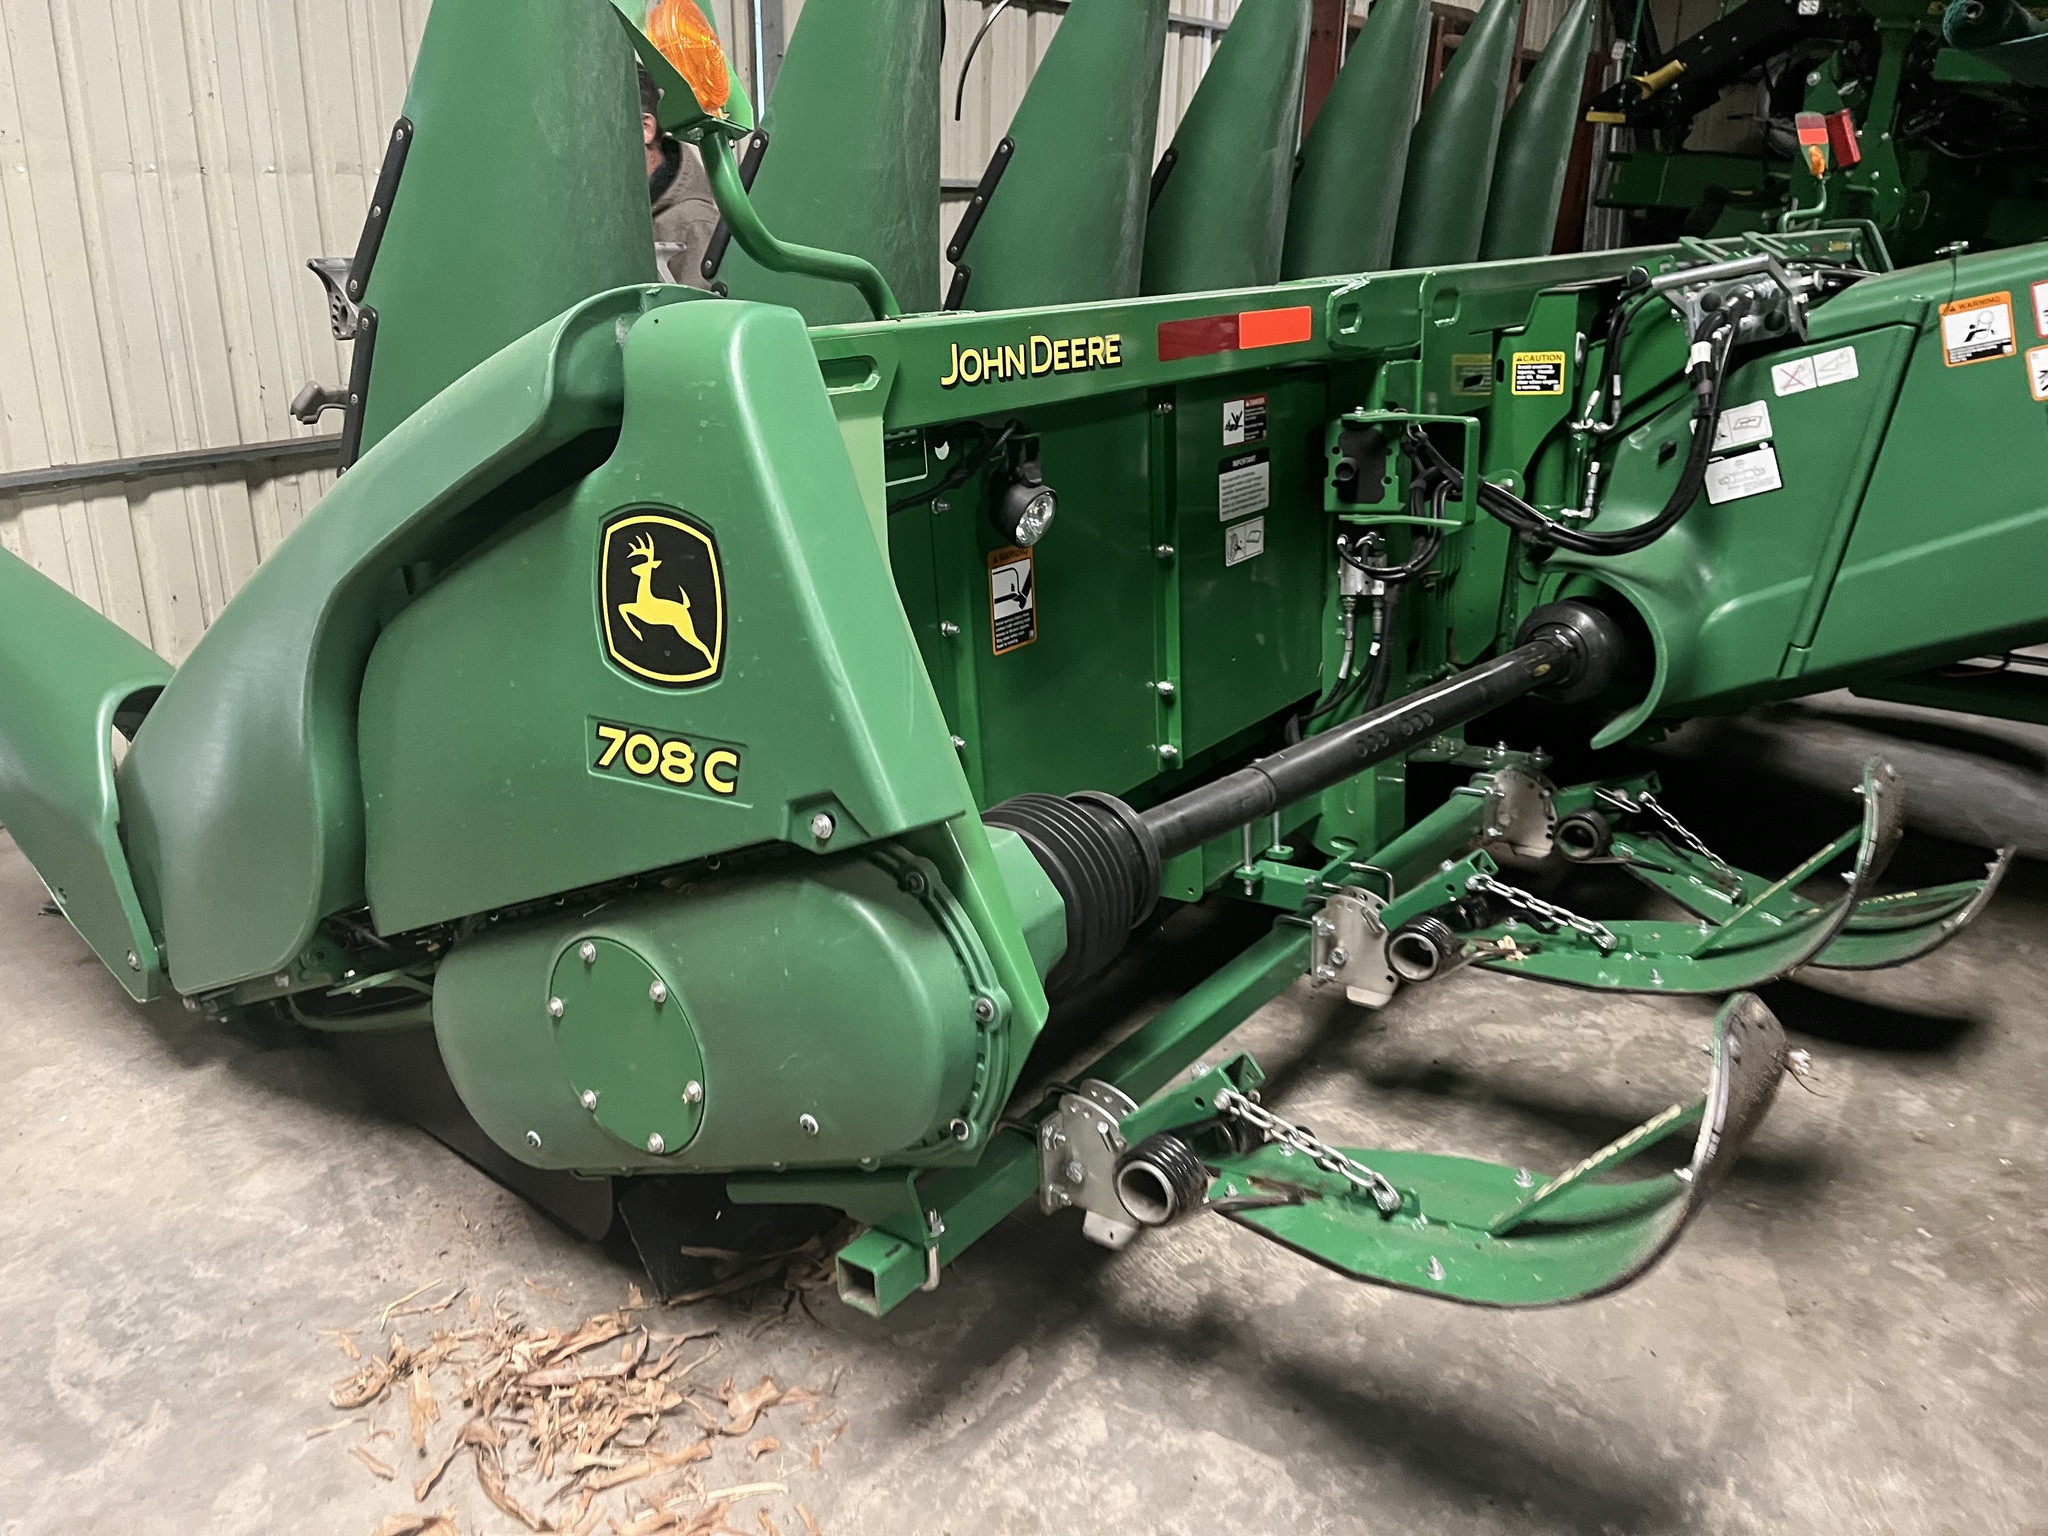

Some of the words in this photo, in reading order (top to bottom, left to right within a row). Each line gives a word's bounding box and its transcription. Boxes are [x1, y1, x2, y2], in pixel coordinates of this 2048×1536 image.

[1958, 296, 2001, 310] WARNING
[941, 343, 1026, 387] JOHN
[1030, 333, 1122, 375] DEERE
[1523, 354, 1562, 362] CAUTION
[597, 724, 697, 784] 708
[703, 749, 739, 794] C
